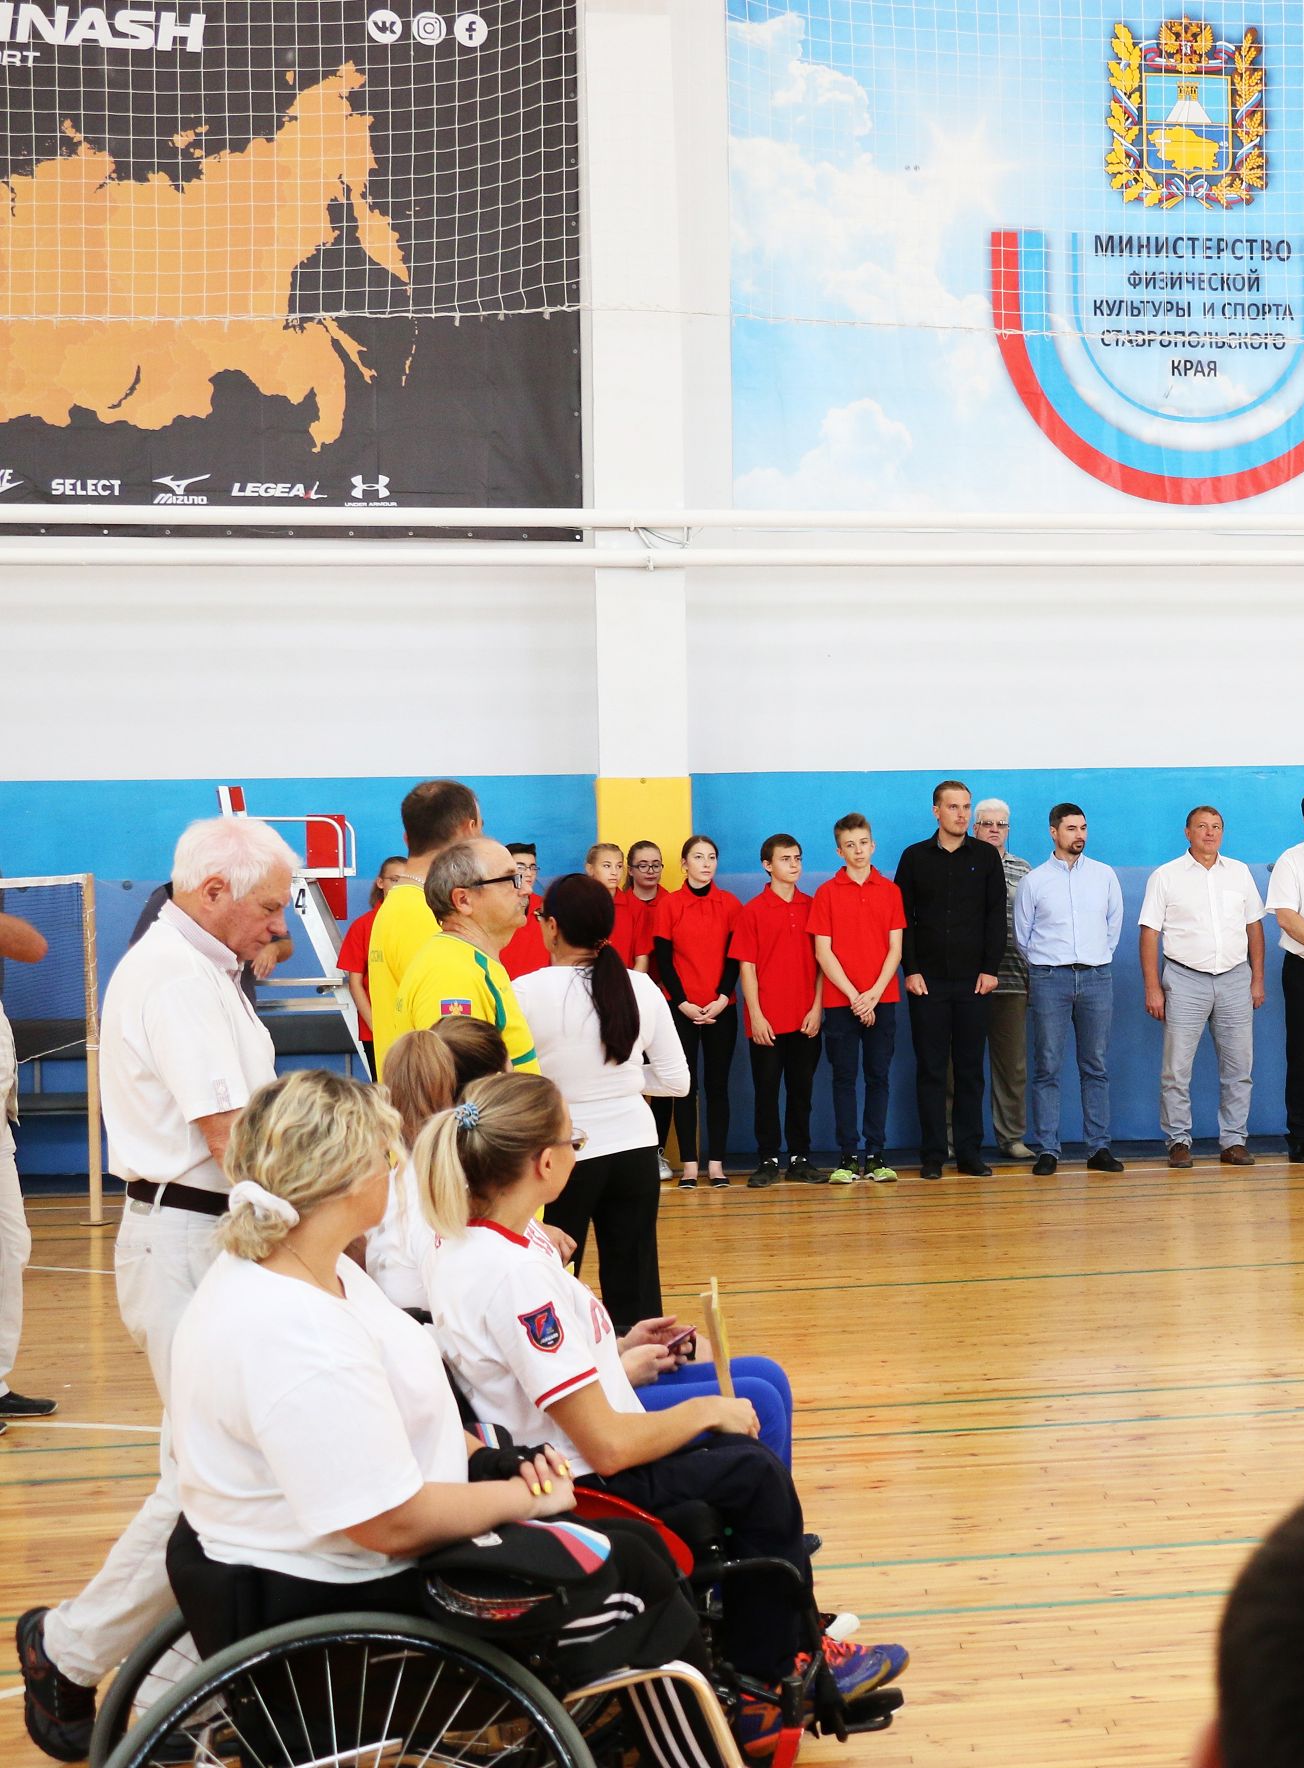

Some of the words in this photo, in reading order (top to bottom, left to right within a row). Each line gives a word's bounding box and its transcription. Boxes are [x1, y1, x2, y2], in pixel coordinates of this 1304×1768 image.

[0, 50, 41, 67] RT
[1094, 234, 1292, 262] МИНИСТЕРСТВО
[1127, 268, 1260, 292] ФИЗИЧЕСКОЙ
[1093, 299, 1191, 319] КУЛЬТУРЫ
[1203, 302, 1215, 319] И
[1221, 302, 1294, 321] СПОРТА
[1100, 329, 1286, 351] СТАВРОПОЛЬСКОГО
[1170, 359, 1218, 378] КРАЯ
[51, 479, 121, 496] SELECT
[231, 482, 305, 497] LEGEA
[295, 888, 306, 914] 4
